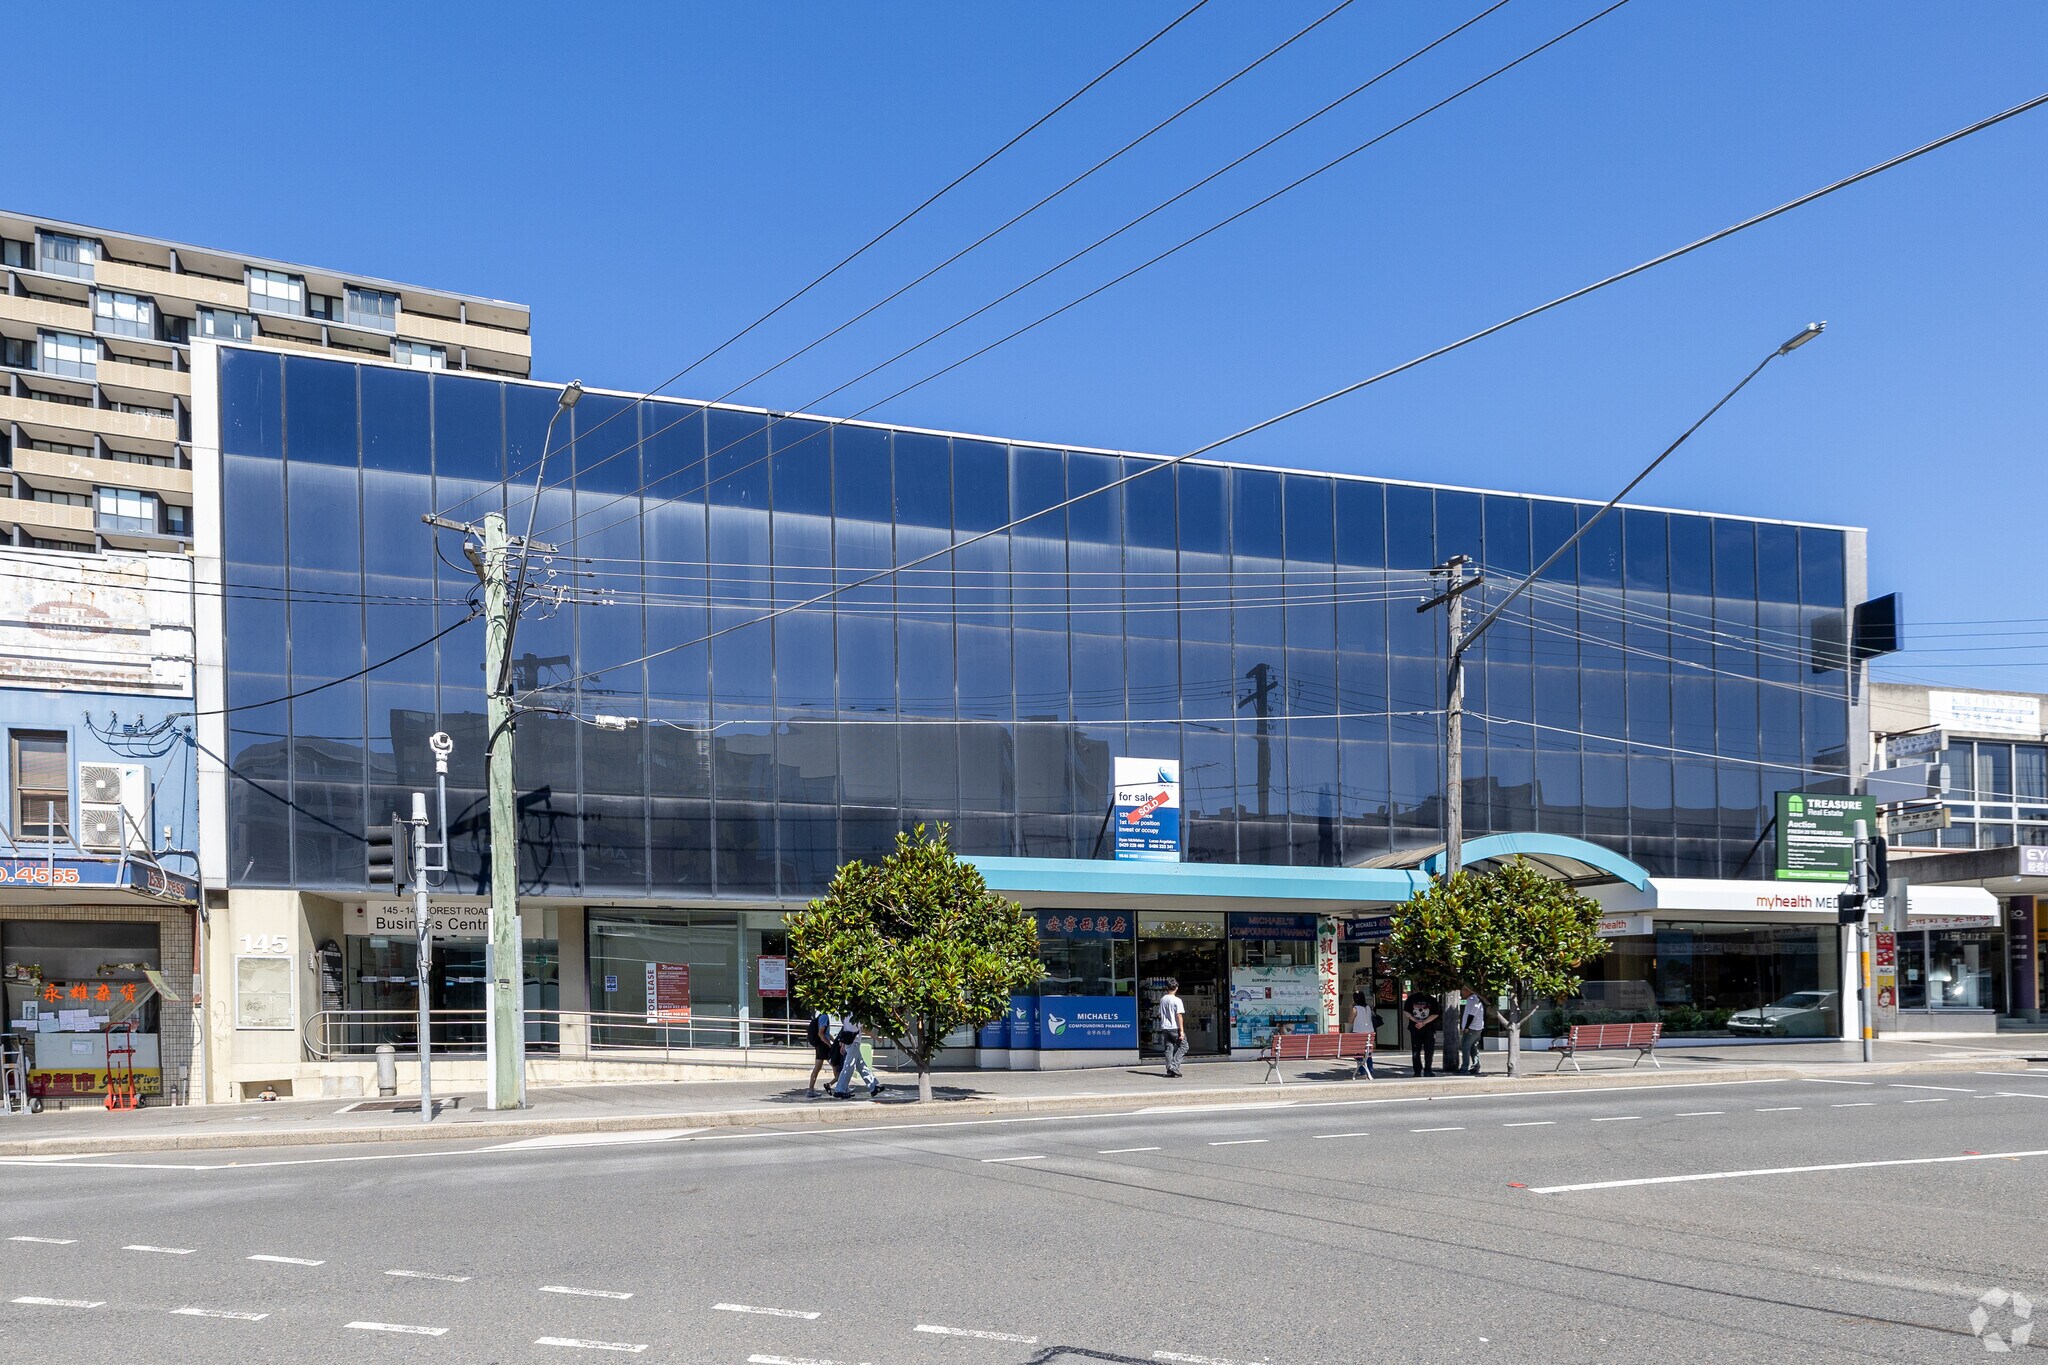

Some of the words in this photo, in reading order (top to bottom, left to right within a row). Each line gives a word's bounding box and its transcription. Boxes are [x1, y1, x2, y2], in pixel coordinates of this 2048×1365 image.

[49, 606, 87, 617] BEST
[1119, 792, 1132, 801] for
[1134, 793, 1153, 802] sale
[1138, 799, 1159, 816] SOLD
[1807, 799, 1862, 810] TREASURE
[1823, 809, 1844, 817] Estate
[1787, 820, 1817, 829] Auction
[2026, 848, 2048, 861] EY
[1756, 894, 1813, 910] myhealth
[382, 906, 398, 915] 145
[426, 906, 461, 915] FOREST
[464, 907, 489, 916] ROAD
[376, 917, 442, 930] Busins
[448, 917, 489, 931] Centr
[1248, 916, 1295, 926] MICHAEL'S
[1355, 920, 1377, 929] MICHAEL'S
[1231, 927, 1280, 937] COMPOUNDING
[1280, 928, 1316, 937] PHARMACY
[240, 934, 289, 954] 145
[647, 969, 655, 995] LEASE
[44, 983, 138, 1004] 永雄杂货
